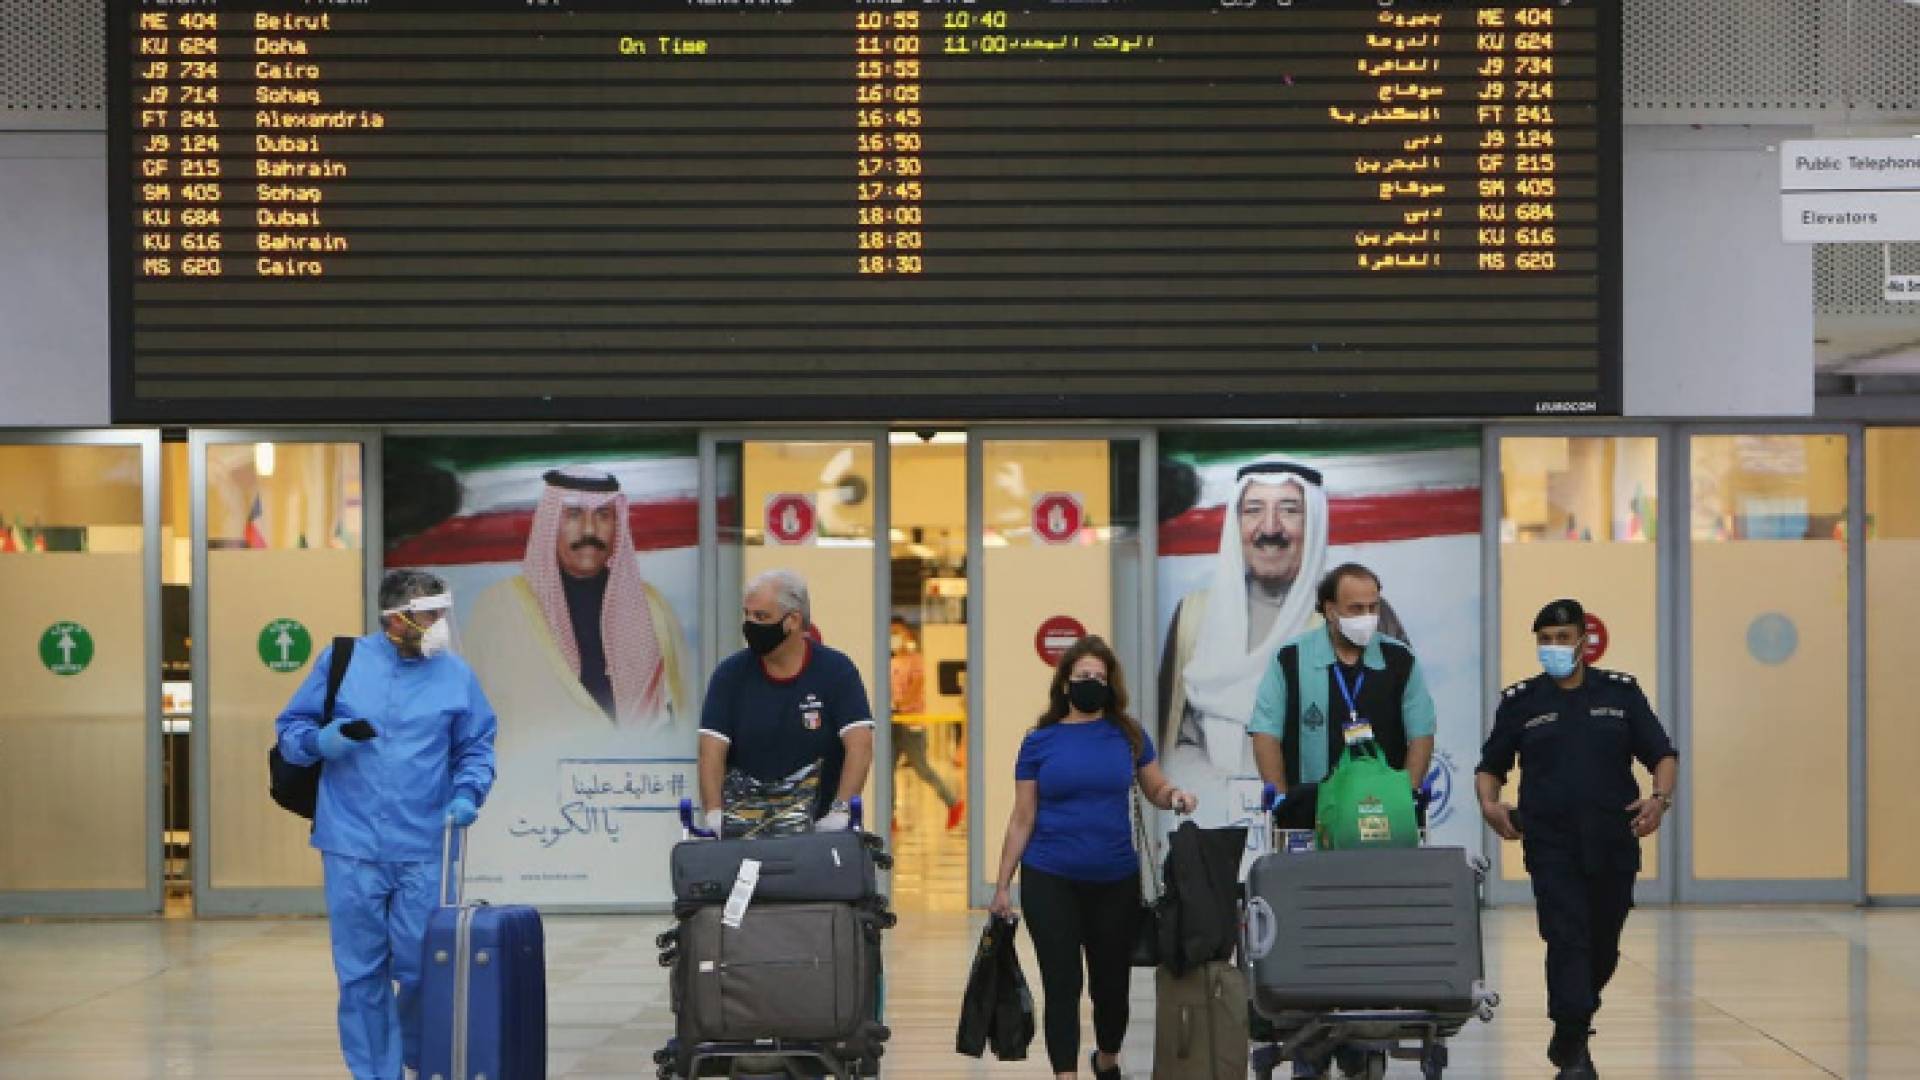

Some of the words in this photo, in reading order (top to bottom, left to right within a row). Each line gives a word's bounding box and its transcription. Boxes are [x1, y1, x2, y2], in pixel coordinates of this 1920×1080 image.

[140, 13, 167, 30] ME
[178, 13, 216, 30] 404
[255, 13, 330, 30] Beirut
[856, 11, 920, 30] 10:55
[944, 11, 1007, 28] 10:40
[1477, 8, 1505, 27] ME
[1515, 8, 1553, 26] 404
[141, 38, 167, 54] KU
[180, 38, 217, 54] 624
[255, 38, 308, 54] Doha
[620, 38, 646, 54] On
[659, 38, 708, 54] Time
[857, 35, 921, 54] 11:00
[944, 35, 1007, 54] 11:00
[1477, 33, 1505, 51] KU
[1515, 32, 1553, 51] 624
[142, 62, 168, 79] J9
[181, 62, 218, 79] 734
[256, 62, 319, 79] Cairo
[857, 59, 921, 78] 15:55
[1478, 57, 1505, 76] J9
[1515, 57, 1553, 75] 734
[142, 86, 168, 103] J9
[181, 86, 218, 103] 714
[256, 87, 321, 106] Sohag
[857, 84, 921, 103] 16:05
[1478, 81, 1505, 100] J9
[1515, 81, 1553, 100] 714
[143, 110, 168, 127] FT
[181, 111, 219, 127] 241
[256, 111, 385, 128] Alexandria
[858, 108, 922, 127] 16:45
[1477, 105, 1504, 124] FT
[1515, 105, 1554, 124] 241
[144, 135, 170, 152] J9
[181, 135, 220, 152] 124
[256, 136, 320, 153] Dubai
[858, 132, 922, 152] 16:50
[1479, 130, 1505, 148] J9
[1515, 130, 1554, 148] 124
[143, 159, 168, 176] GF
[181, 159, 220, 176] 215
[256, 159, 347, 176] Bahrain
[858, 157, 922, 176] 17:30
[1477, 154, 1505, 173] GF
[1516, 154, 1555, 173] 215
[1795, 156, 1842, 171] Public
[143, 184, 170, 200] SM
[181, 184, 221, 200] 405
[257, 184, 322, 202] Sohag
[858, 181, 922, 200] 17:45
[1478, 178, 1505, 197] SM
[1515, 178, 1555, 197] 405
[143, 208, 170, 225] KU
[181, 208, 221, 226] 684
[257, 208, 320, 226] Dubai
[858, 206, 922, 225] 18:00
[1478, 203, 1505, 221] KU
[1515, 203, 1555, 221] 684
[1801, 210, 1878, 225] Elevators
[143, 233, 170, 251] KU
[181, 233, 222, 251] 616
[257, 233, 347, 251] Bahrain
[858, 231, 922, 249] 18:20
[1478, 228, 1505, 246] KU
[1515, 228, 1555, 246] 616
[143, 257, 170, 275] MS
[181, 257, 222, 275] 620
[257, 257, 322, 275] Cairo
[858, 255, 922, 274] 18:30
[1478, 252, 1505, 270] MS
[1515, 252, 1555, 270] 620
